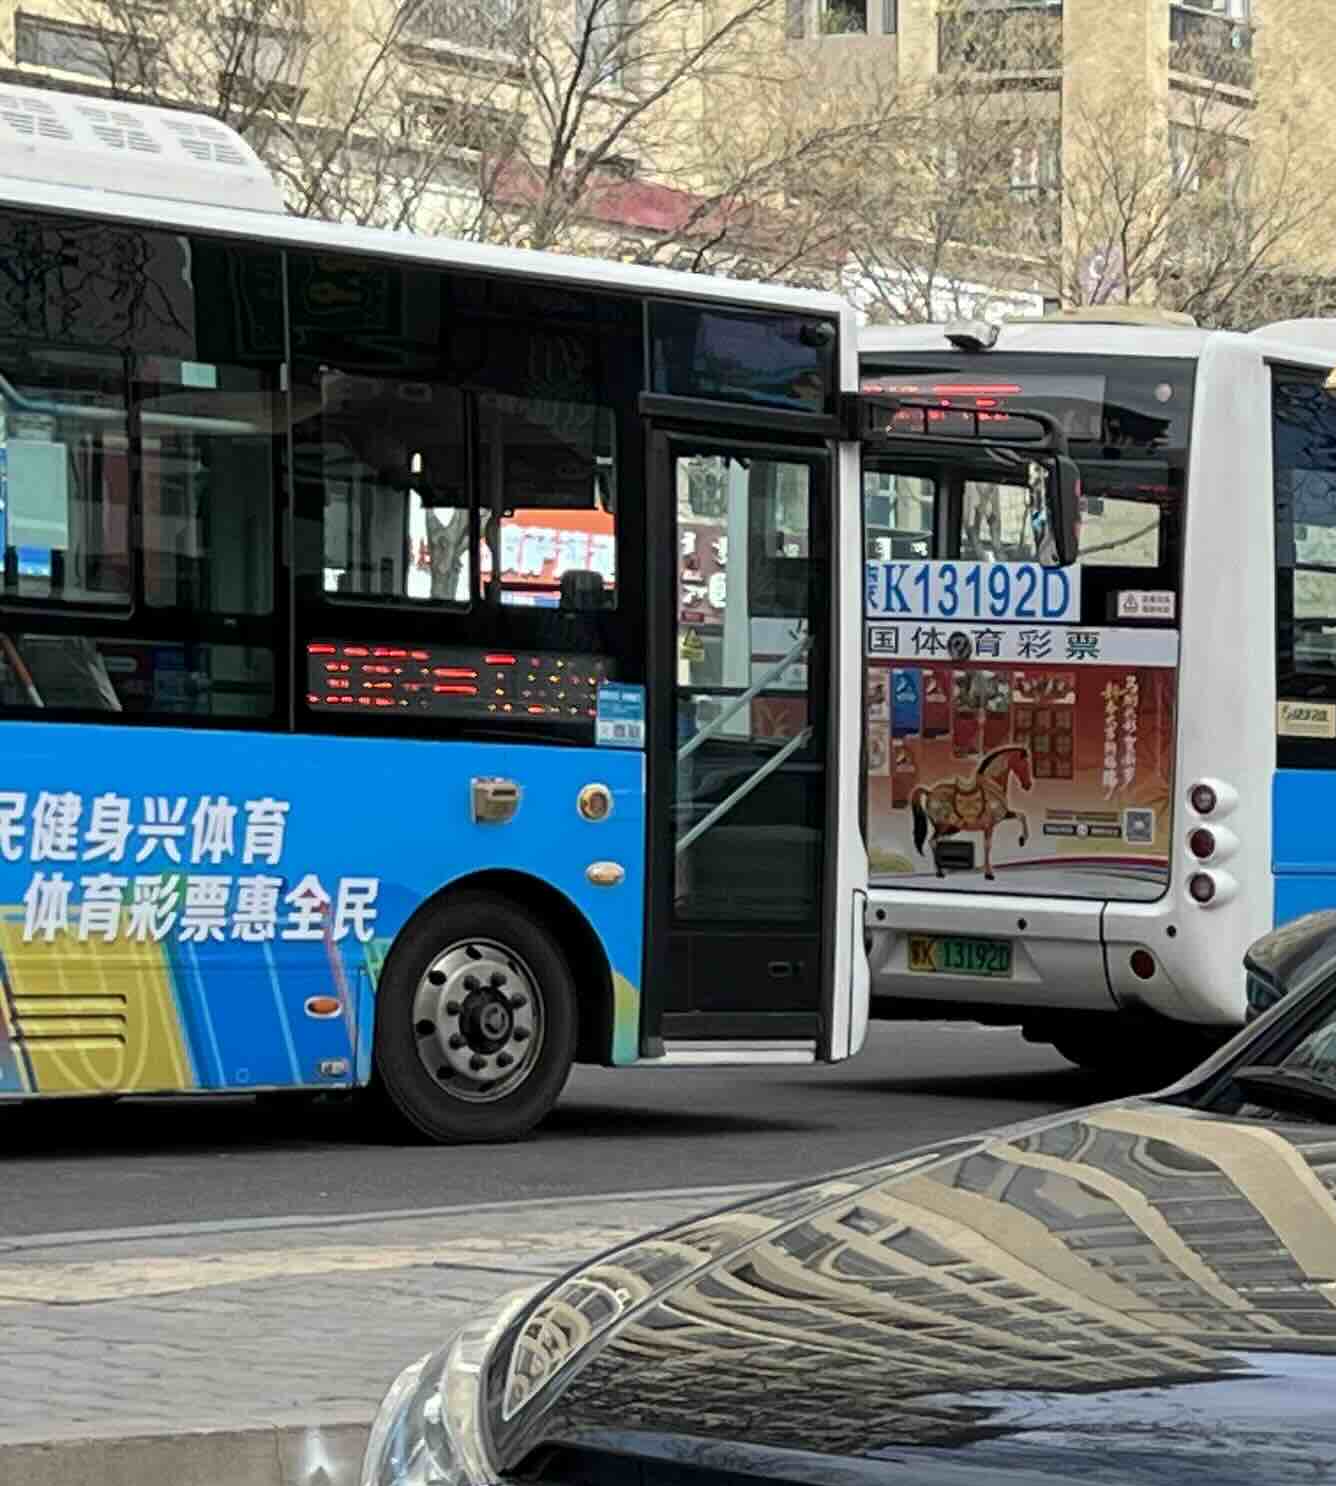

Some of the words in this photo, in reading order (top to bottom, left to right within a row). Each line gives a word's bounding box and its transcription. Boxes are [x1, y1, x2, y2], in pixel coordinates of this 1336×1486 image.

[0, 791, 290, 865] 民健身兴体育
[22, 871, 381, 943] 体育彩票惠全民
